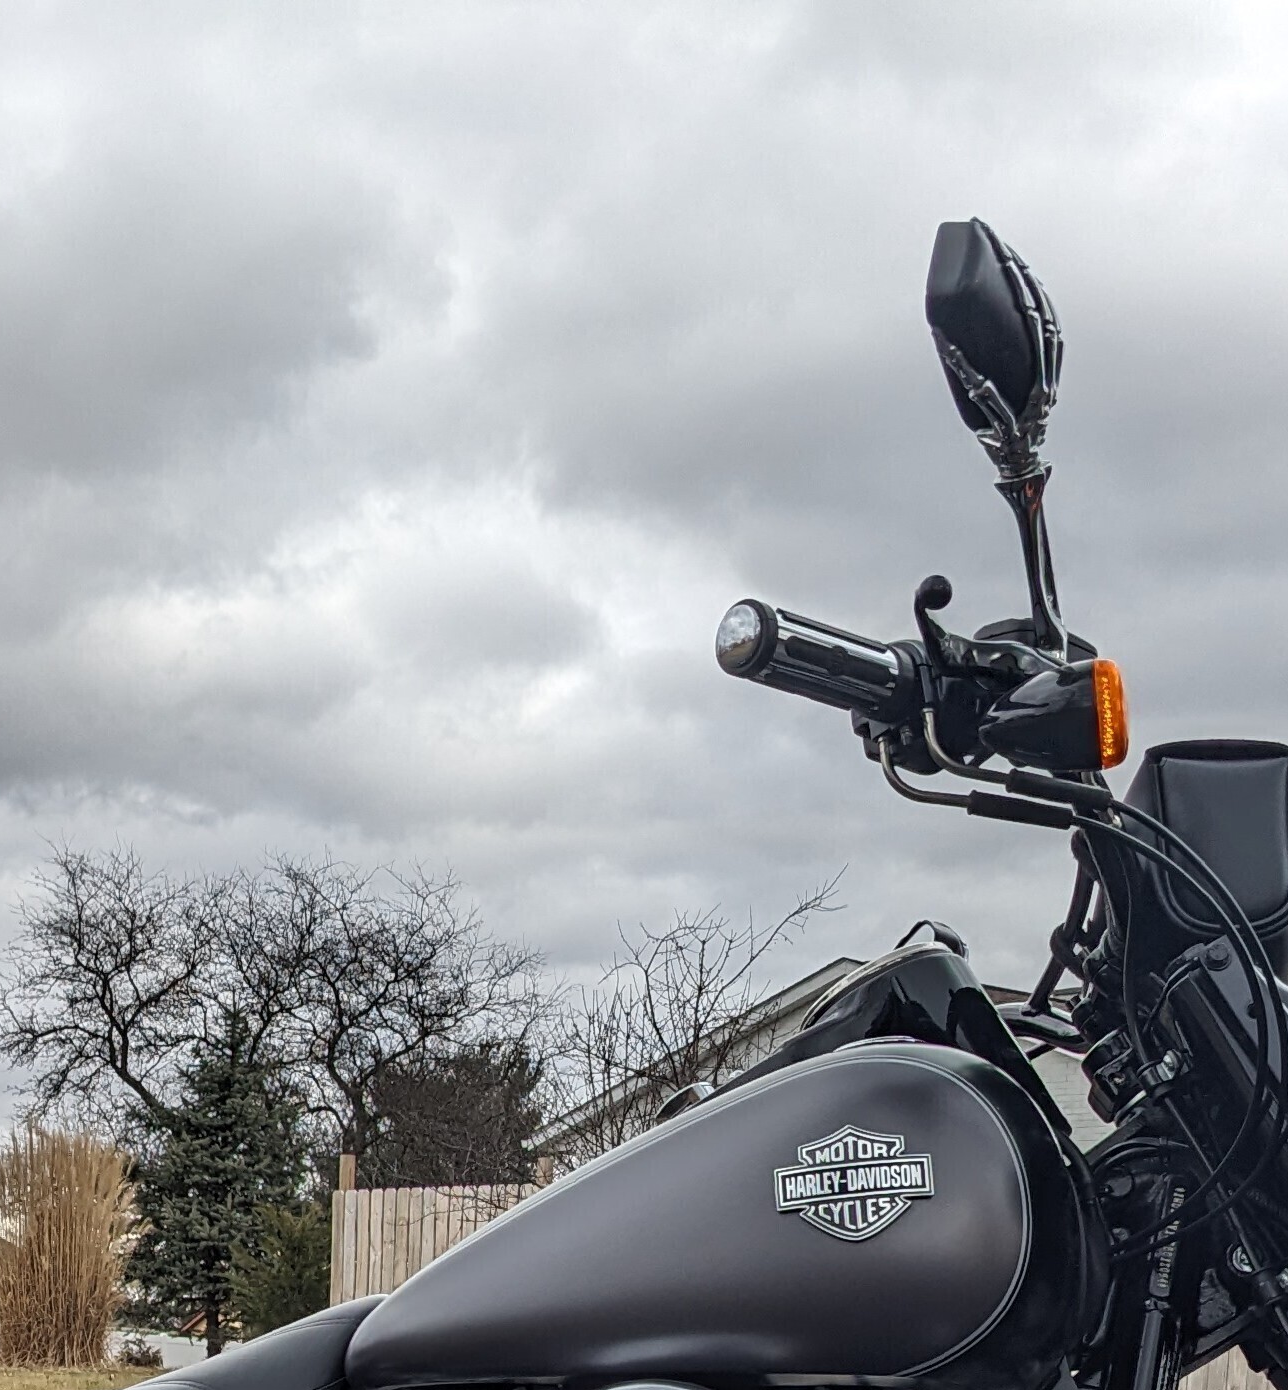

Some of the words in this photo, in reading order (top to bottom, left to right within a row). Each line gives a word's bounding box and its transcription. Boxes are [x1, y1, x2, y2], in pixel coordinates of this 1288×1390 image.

[815, 1136, 889, 1164] MOTOR
[786, 1164, 923, 1200] HARLEY-DAVIDSON
[818, 1197, 891, 1230] CYCLES
